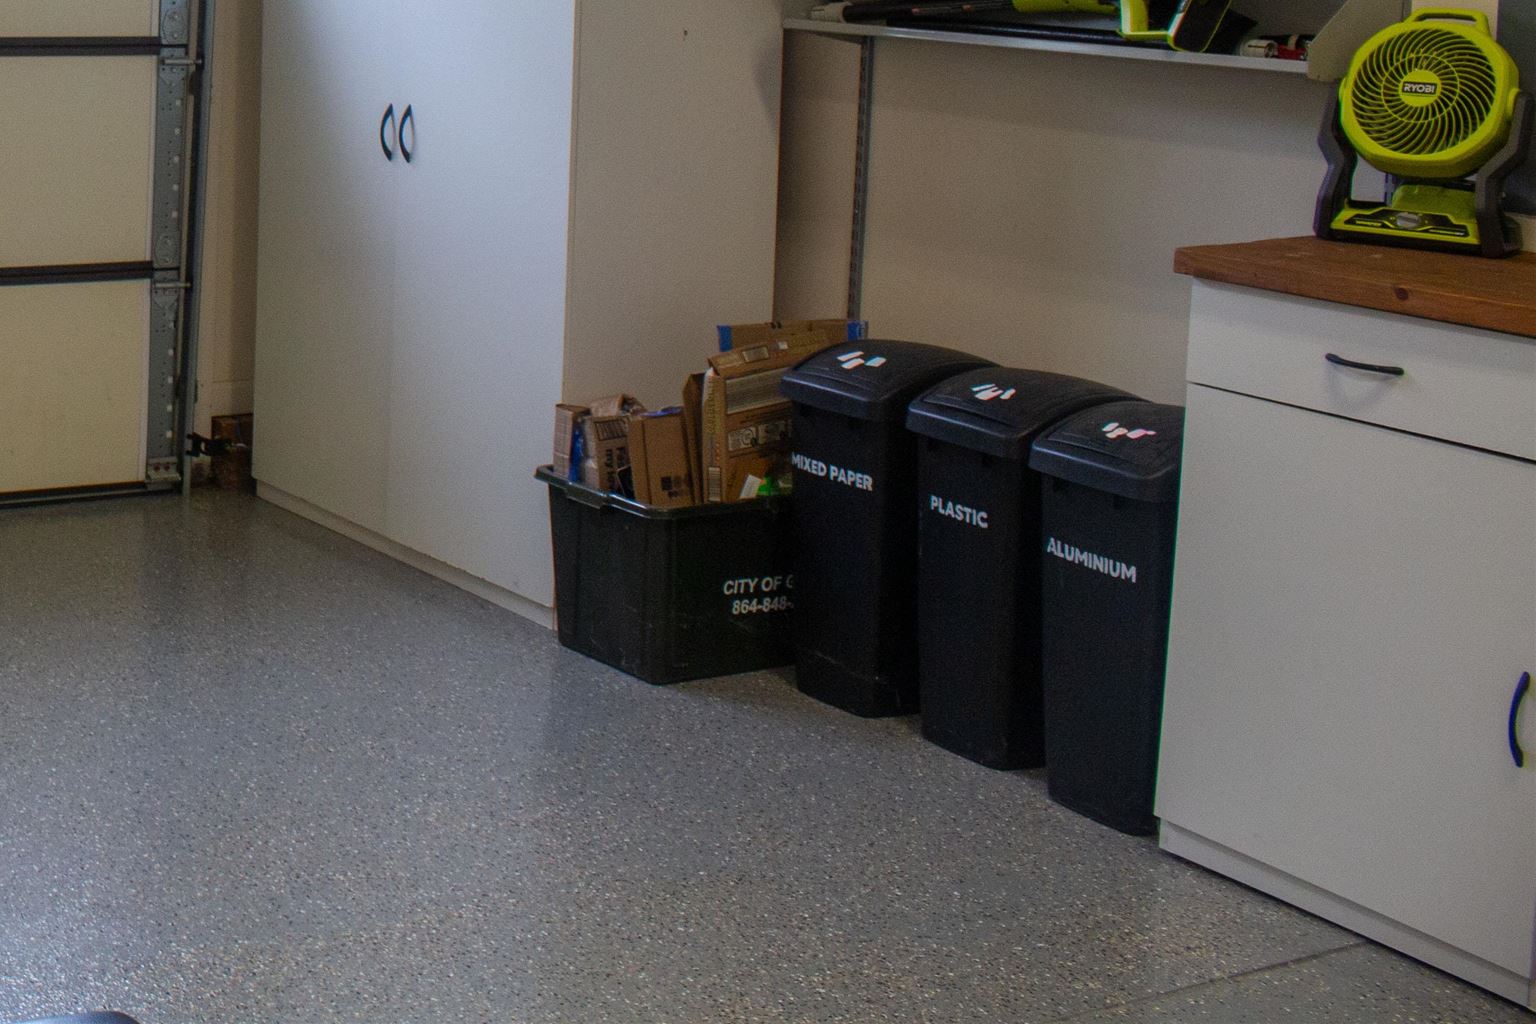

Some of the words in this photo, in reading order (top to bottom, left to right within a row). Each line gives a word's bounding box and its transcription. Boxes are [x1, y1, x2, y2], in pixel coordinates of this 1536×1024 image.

[1403, 83, 1435, 93] RYOBI
[791, 452, 827, 477] MIXED
[829, 464, 873, 492] PAPER
[930, 494, 989, 529] PLASTIC
[1046, 537, 1137, 584] ALUMINIUM
[723, 577, 759, 596] CITY
[761, 575, 783, 592] OF
